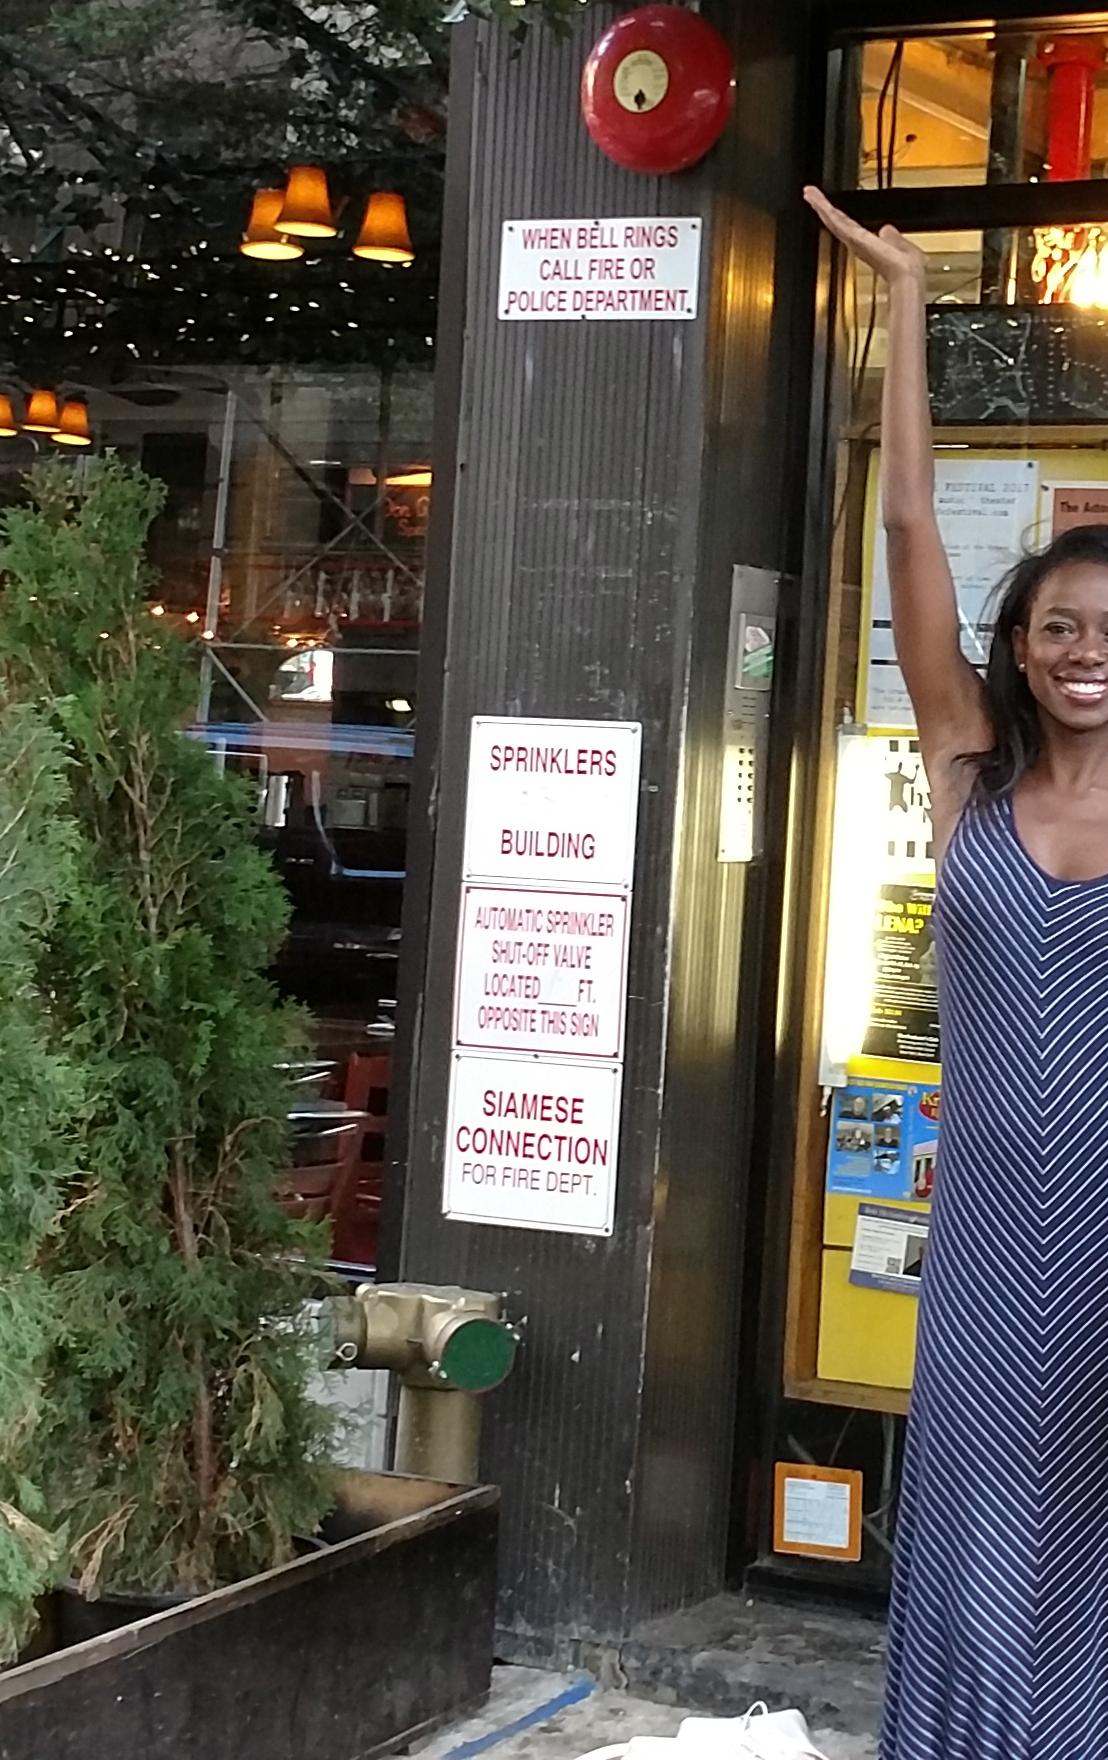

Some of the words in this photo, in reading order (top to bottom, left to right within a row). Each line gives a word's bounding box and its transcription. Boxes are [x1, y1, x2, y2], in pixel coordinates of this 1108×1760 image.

[522, 228, 571, 249] WHEN
[577, 226, 618, 248] BELL
[624, 225, 678, 248] RINGS
[540, 259, 582, 281] CALL
[588, 258, 625, 280] FIRE
[630, 257, 656, 279] OR
[507, 290, 567, 312] POLICE
[1060, 501, 1079, 513] The
[490, 745, 617, 777] SPRINKLERS
[501, 829, 596, 860] BUILDING
[475, 906, 543, 933] AUTOMATIC
[546, 910, 615, 937] SPRINKLER
[491, 940, 550, 966] SHUT-OFF
[554, 944, 592, 970] VALVE
[484, 973, 540, 1000] LOCATED
[478, 1005, 537, 1032] OPPOSITE
[540, 1009, 567, 1035] THIS
[570, 1012, 599, 1037] SIGN
[483, 1090, 584, 1124] SIAMESE
[456, 1126, 608, 1166] CONNECTION
[462, 1162, 496, 1186] FOR
[502, 1166, 541, 1190] FIRE
[547, 1171, 597, 1196] DEPT.
